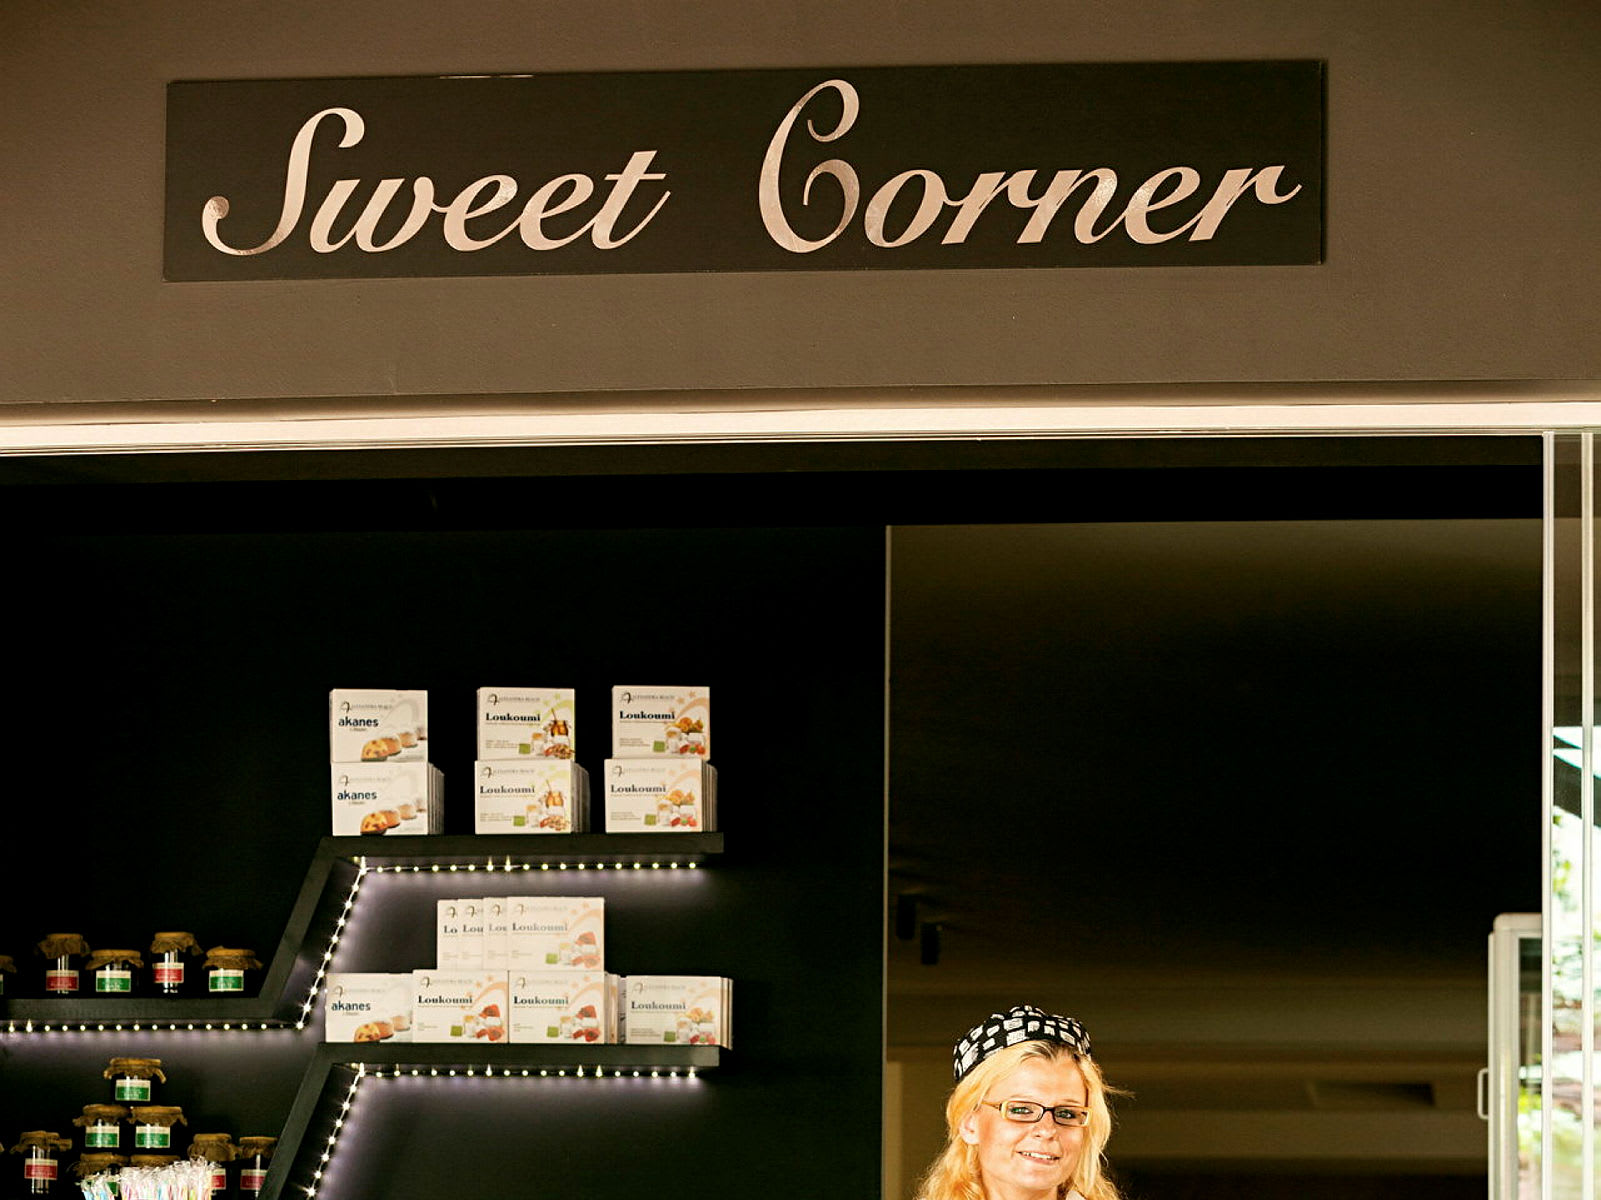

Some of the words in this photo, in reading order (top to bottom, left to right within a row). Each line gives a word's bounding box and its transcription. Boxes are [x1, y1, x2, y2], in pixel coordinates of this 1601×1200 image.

[202, 106, 671, 256] Sweet
[757, 78, 1302, 253] Corner
[485, 712, 541, 722] Loukoumi
[619, 710, 675, 720] Loukoumi
[338, 716, 379, 728] akanes
[479, 785, 536, 795] Loukoumi
[610, 784, 666, 793] Loukoumi
[337, 789, 378, 801] akanes
[511, 922, 568, 932] Loukoumi
[417, 994, 473, 1004] Loukoumi
[513, 995, 569, 1005] Loukoumi
[331, 1001, 371, 1012] akanes
[630, 1000, 687, 1010] Loukoumi
